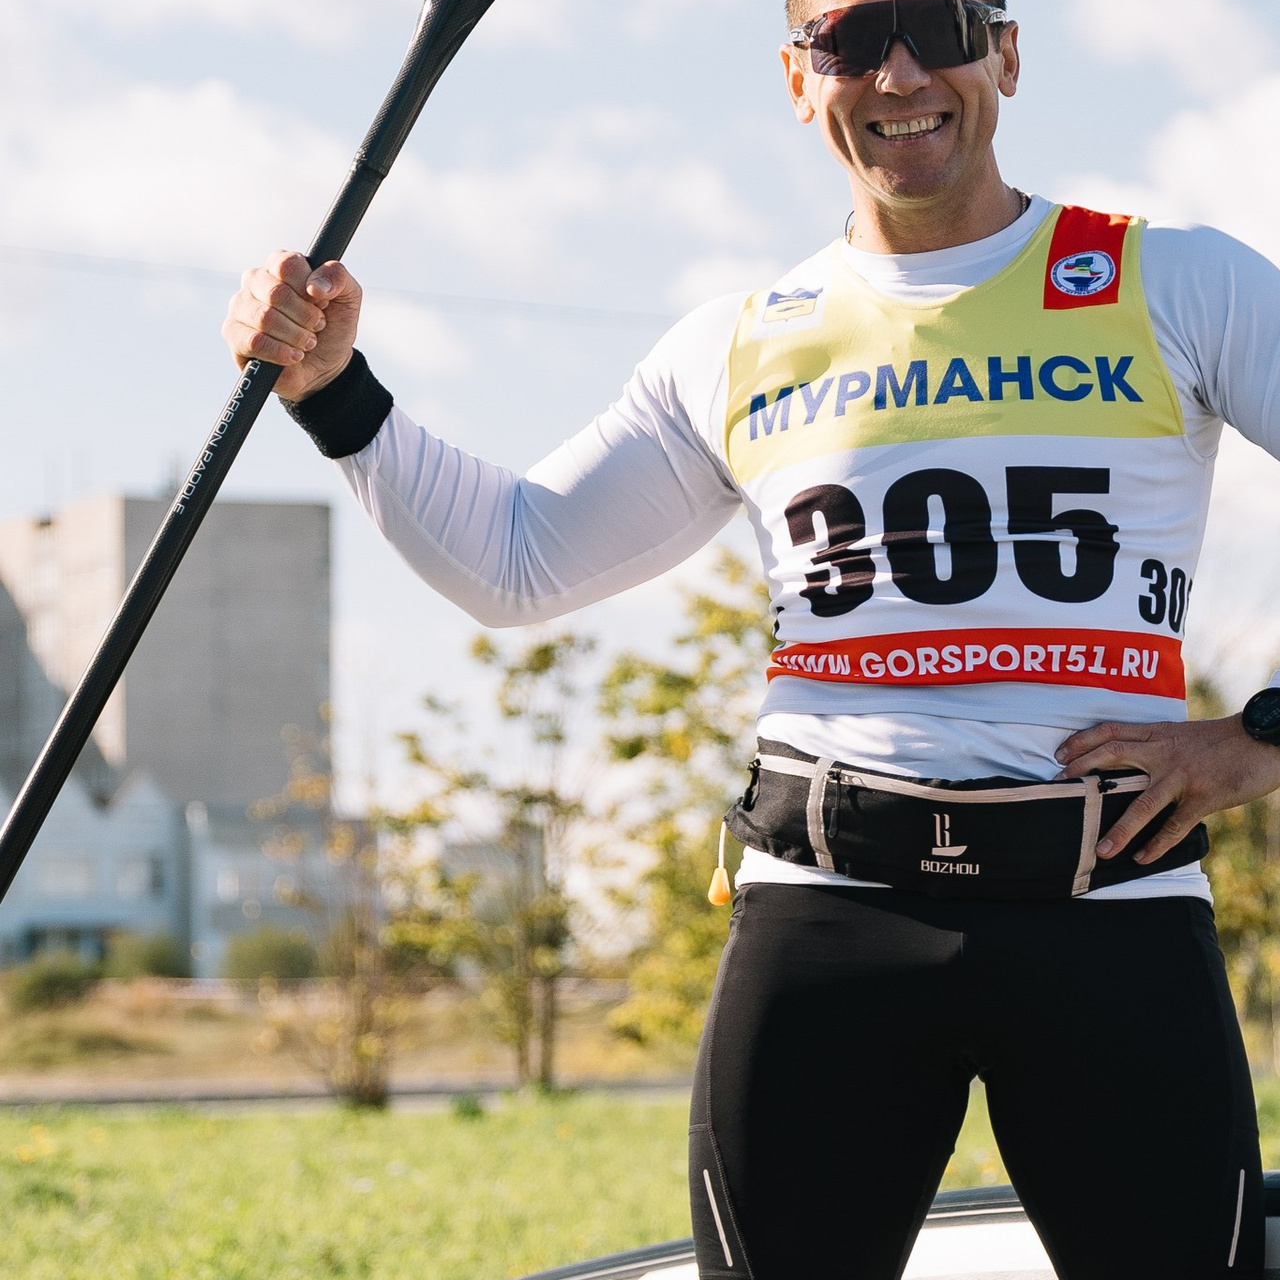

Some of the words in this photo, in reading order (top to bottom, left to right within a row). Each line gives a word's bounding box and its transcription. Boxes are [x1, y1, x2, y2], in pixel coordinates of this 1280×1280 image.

[209, 377, 251, 447] CARBON
[749, 355, 1144, 441] МУРМАНСК
[173, 450, 213, 515] PADDLE
[783, 465, 1121, 618] 305
[1138, 558, 1192, 636] 30
[920, 859, 980, 875] BOZHOU
